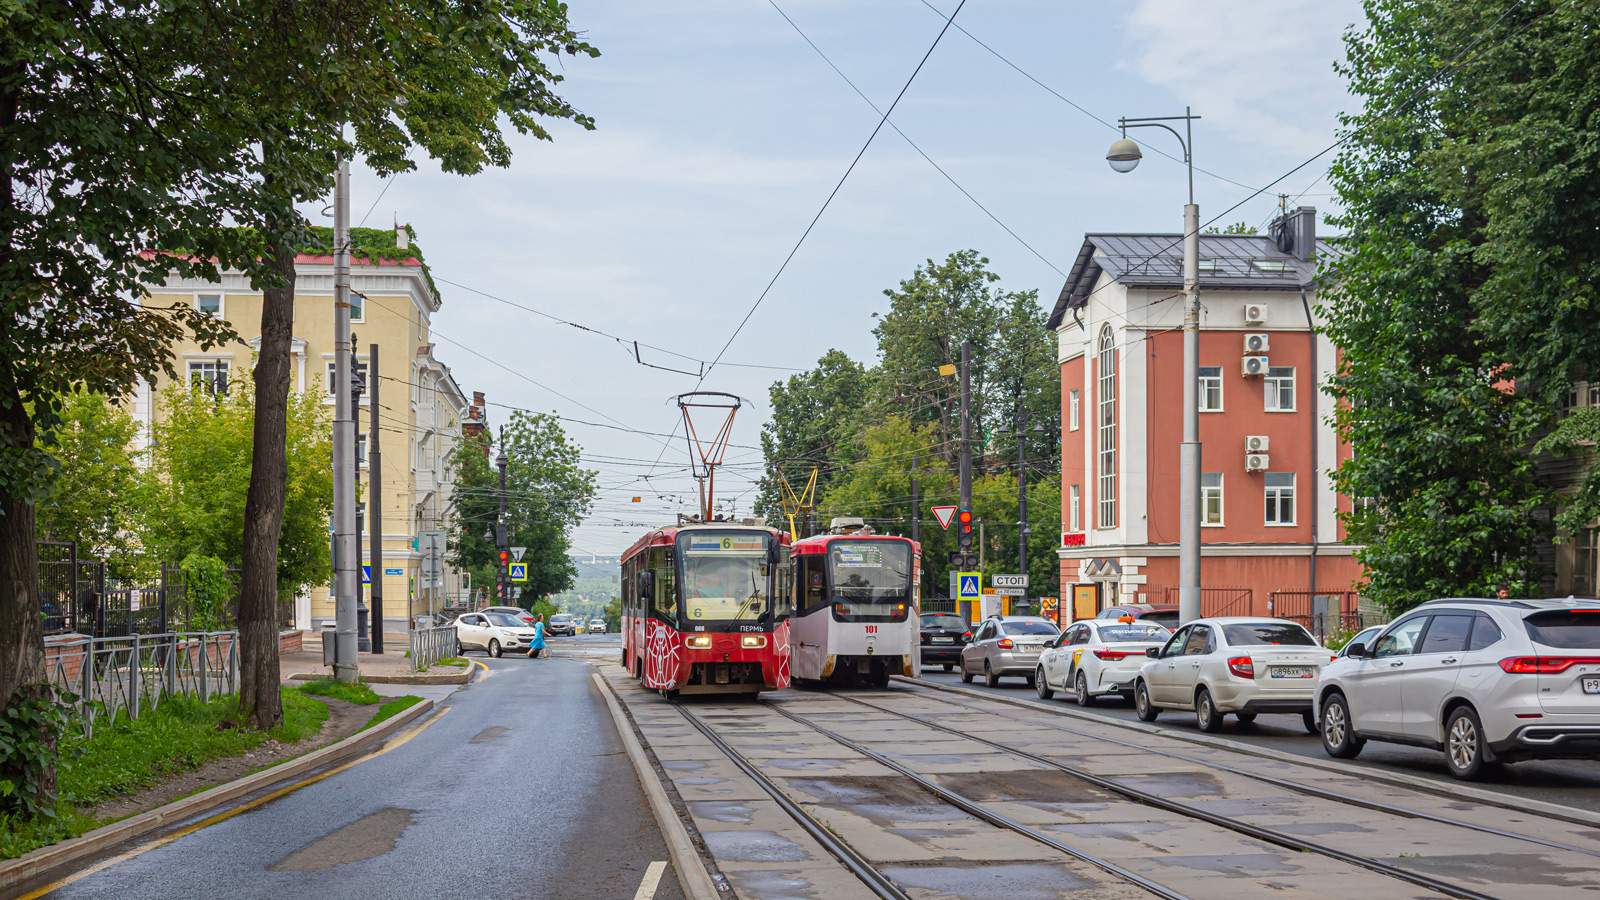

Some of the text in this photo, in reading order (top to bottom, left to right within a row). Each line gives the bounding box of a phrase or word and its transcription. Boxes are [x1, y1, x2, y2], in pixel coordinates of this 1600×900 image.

[722, 537, 731, 549] 6
[996, 576, 1024, 585] СТОП
[693, 608, 702, 618] 6
[865, 625, 878, 634] 101
